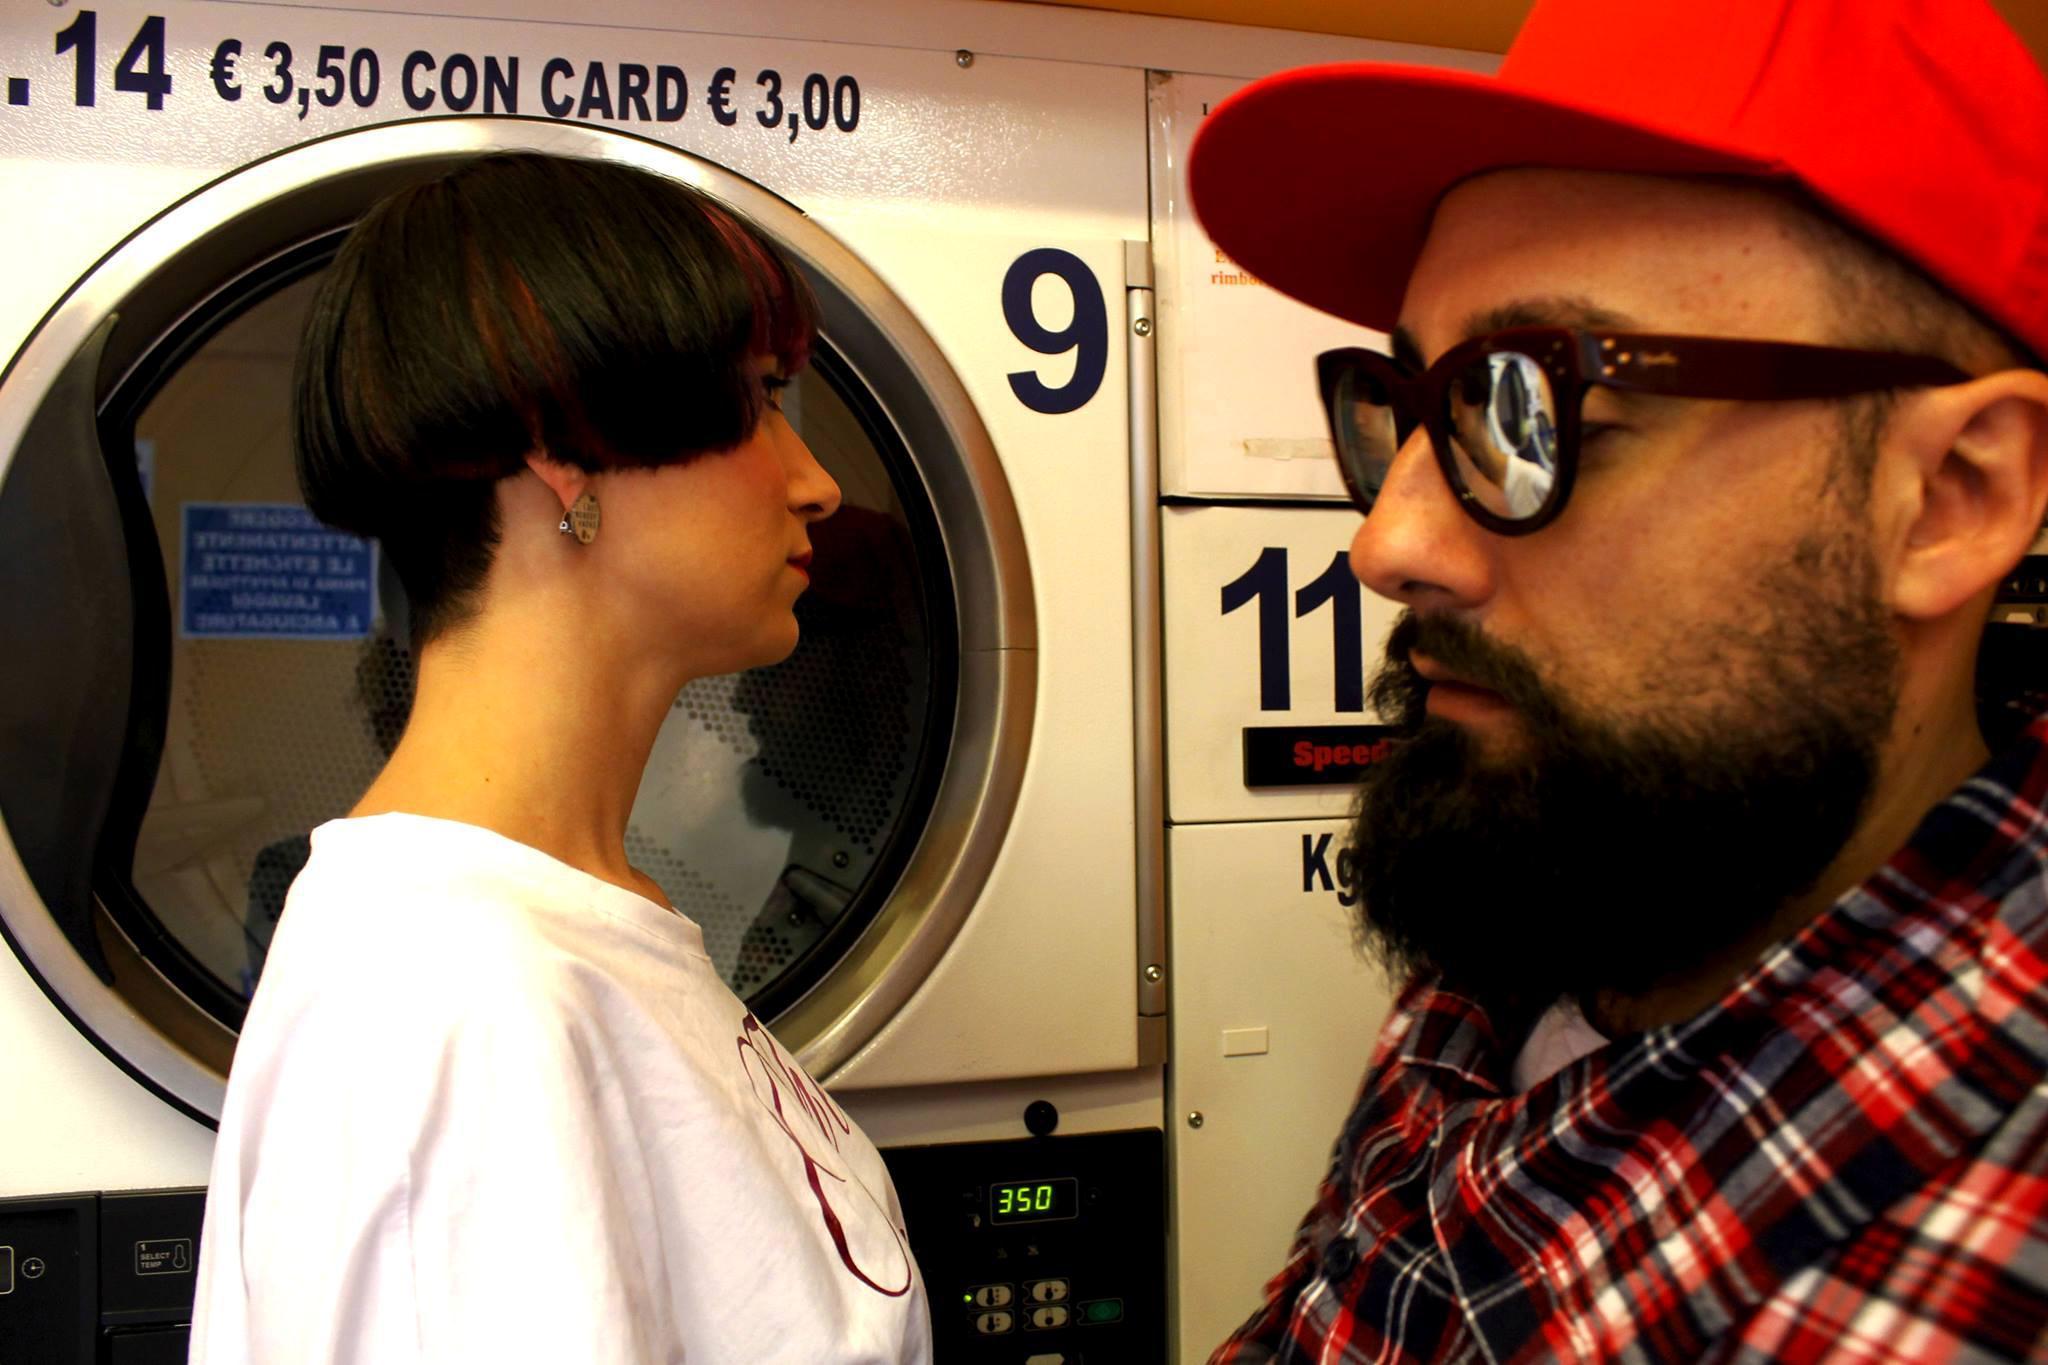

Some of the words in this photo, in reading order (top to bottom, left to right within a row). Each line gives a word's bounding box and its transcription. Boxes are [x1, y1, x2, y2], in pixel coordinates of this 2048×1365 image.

[209, 38, 243, 101] €
[263, 41, 380, 121] 3,50
[402, 50, 519, 114] CON
[541, 57, 688, 122] CARD
[707, 67, 737, 126] €
[756, 69, 860, 144] 3,00
[1001, 247, 1108, 414] 9
[1221, 547, 1364, 713] 11
[1293, 740, 1392, 772] Speed
[998, 1185, 1053, 1214] 350
[140, 1252, 171, 1261] SELECT
[140, 1261, 162, 1269] TEMP
